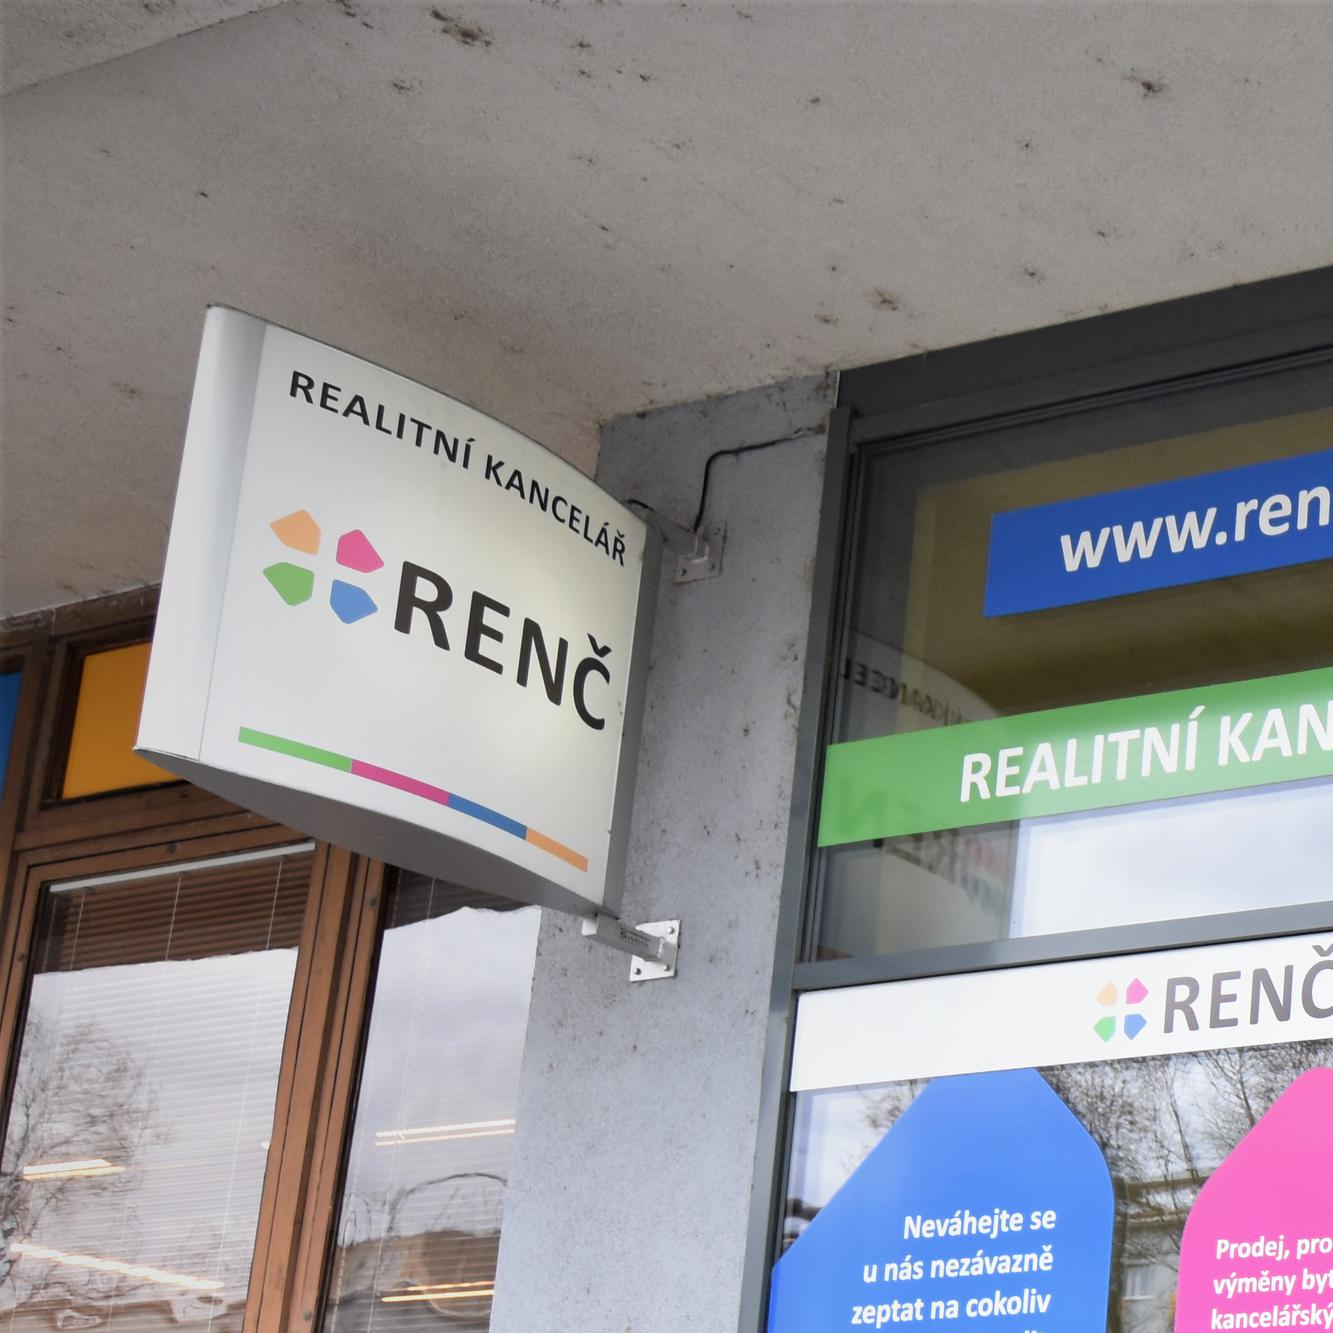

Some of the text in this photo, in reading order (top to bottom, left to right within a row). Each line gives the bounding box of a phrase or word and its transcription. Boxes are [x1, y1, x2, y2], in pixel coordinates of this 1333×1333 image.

[290, 370, 626, 567] REALITNÍ KANCELÁŘ
[394, 561, 611, 730] RENČ
[959, 707, 1205, 803] REALITNÍ
[903, 1208, 1057, 1239] Neváhejte se
[863, 1244, 1054, 1283] u nás nezávazně
[1216, 1235, 1290, 1261] Prodej,
[1213, 1270, 1296, 1299] výměny
[851, 1288, 1051, 1329] zeptat na cokoliv
